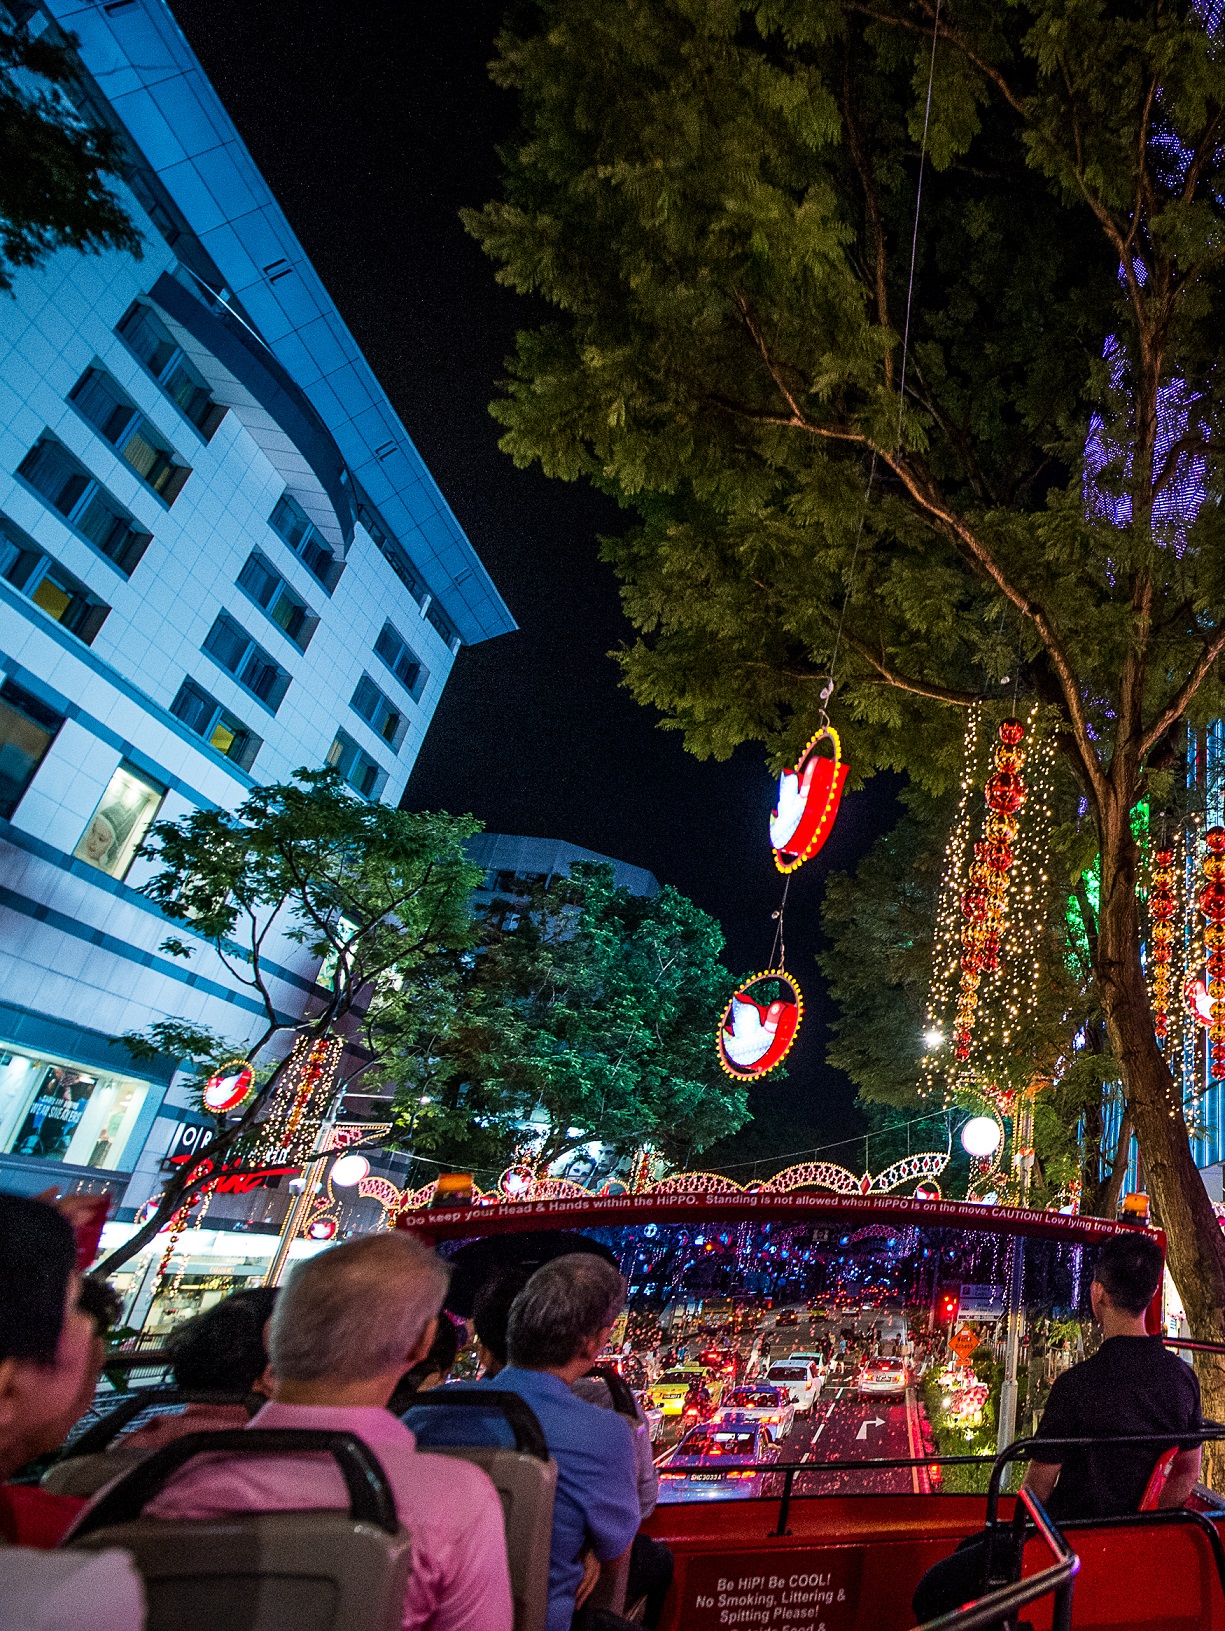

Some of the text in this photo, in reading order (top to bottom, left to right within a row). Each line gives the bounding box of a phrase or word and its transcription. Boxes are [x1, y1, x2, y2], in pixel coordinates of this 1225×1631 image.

[406, 1215, 425, 1226] Do
[429, 1212, 461, 1224] keep
[465, 1208, 495, 1221] your
[498, 1203, 533, 1215] Head
[535, 1201, 545, 1212] &
[550, 1199, 590, 1211] Hands
[593, 1196, 631, 1209] within
[634, 1195, 653, 1206] the
[705, 1194, 758, 1206] Standing
[761, 1195, 770, 1205] is
[773, 1196, 794, 1205] not
[795, 1196, 838, 1206] allowed
[841, 1197, 871, 1207] when
[911, 1200, 920, 1210] is
[923, 1203, 937, 1211] on
[939, 1202, 956, 1212] the
[958, 1206, 988, 1216] move.
[991, 1207, 1043, 1221] CAUTION!
[1045, 1214, 1066, 1225] Low
[1067, 1217, 1092, 1231] lying
[1094, 1222, 1113, 1233] tree
[717, 1578, 734, 1591] Be
[768, 1576, 785, 1589] Be
[789, 1573, 831, 1588] COOL!
[696, 1588, 846, 1609] No Smoking, Littering &
[719, 1604, 820, 1625] Spitting Please!
